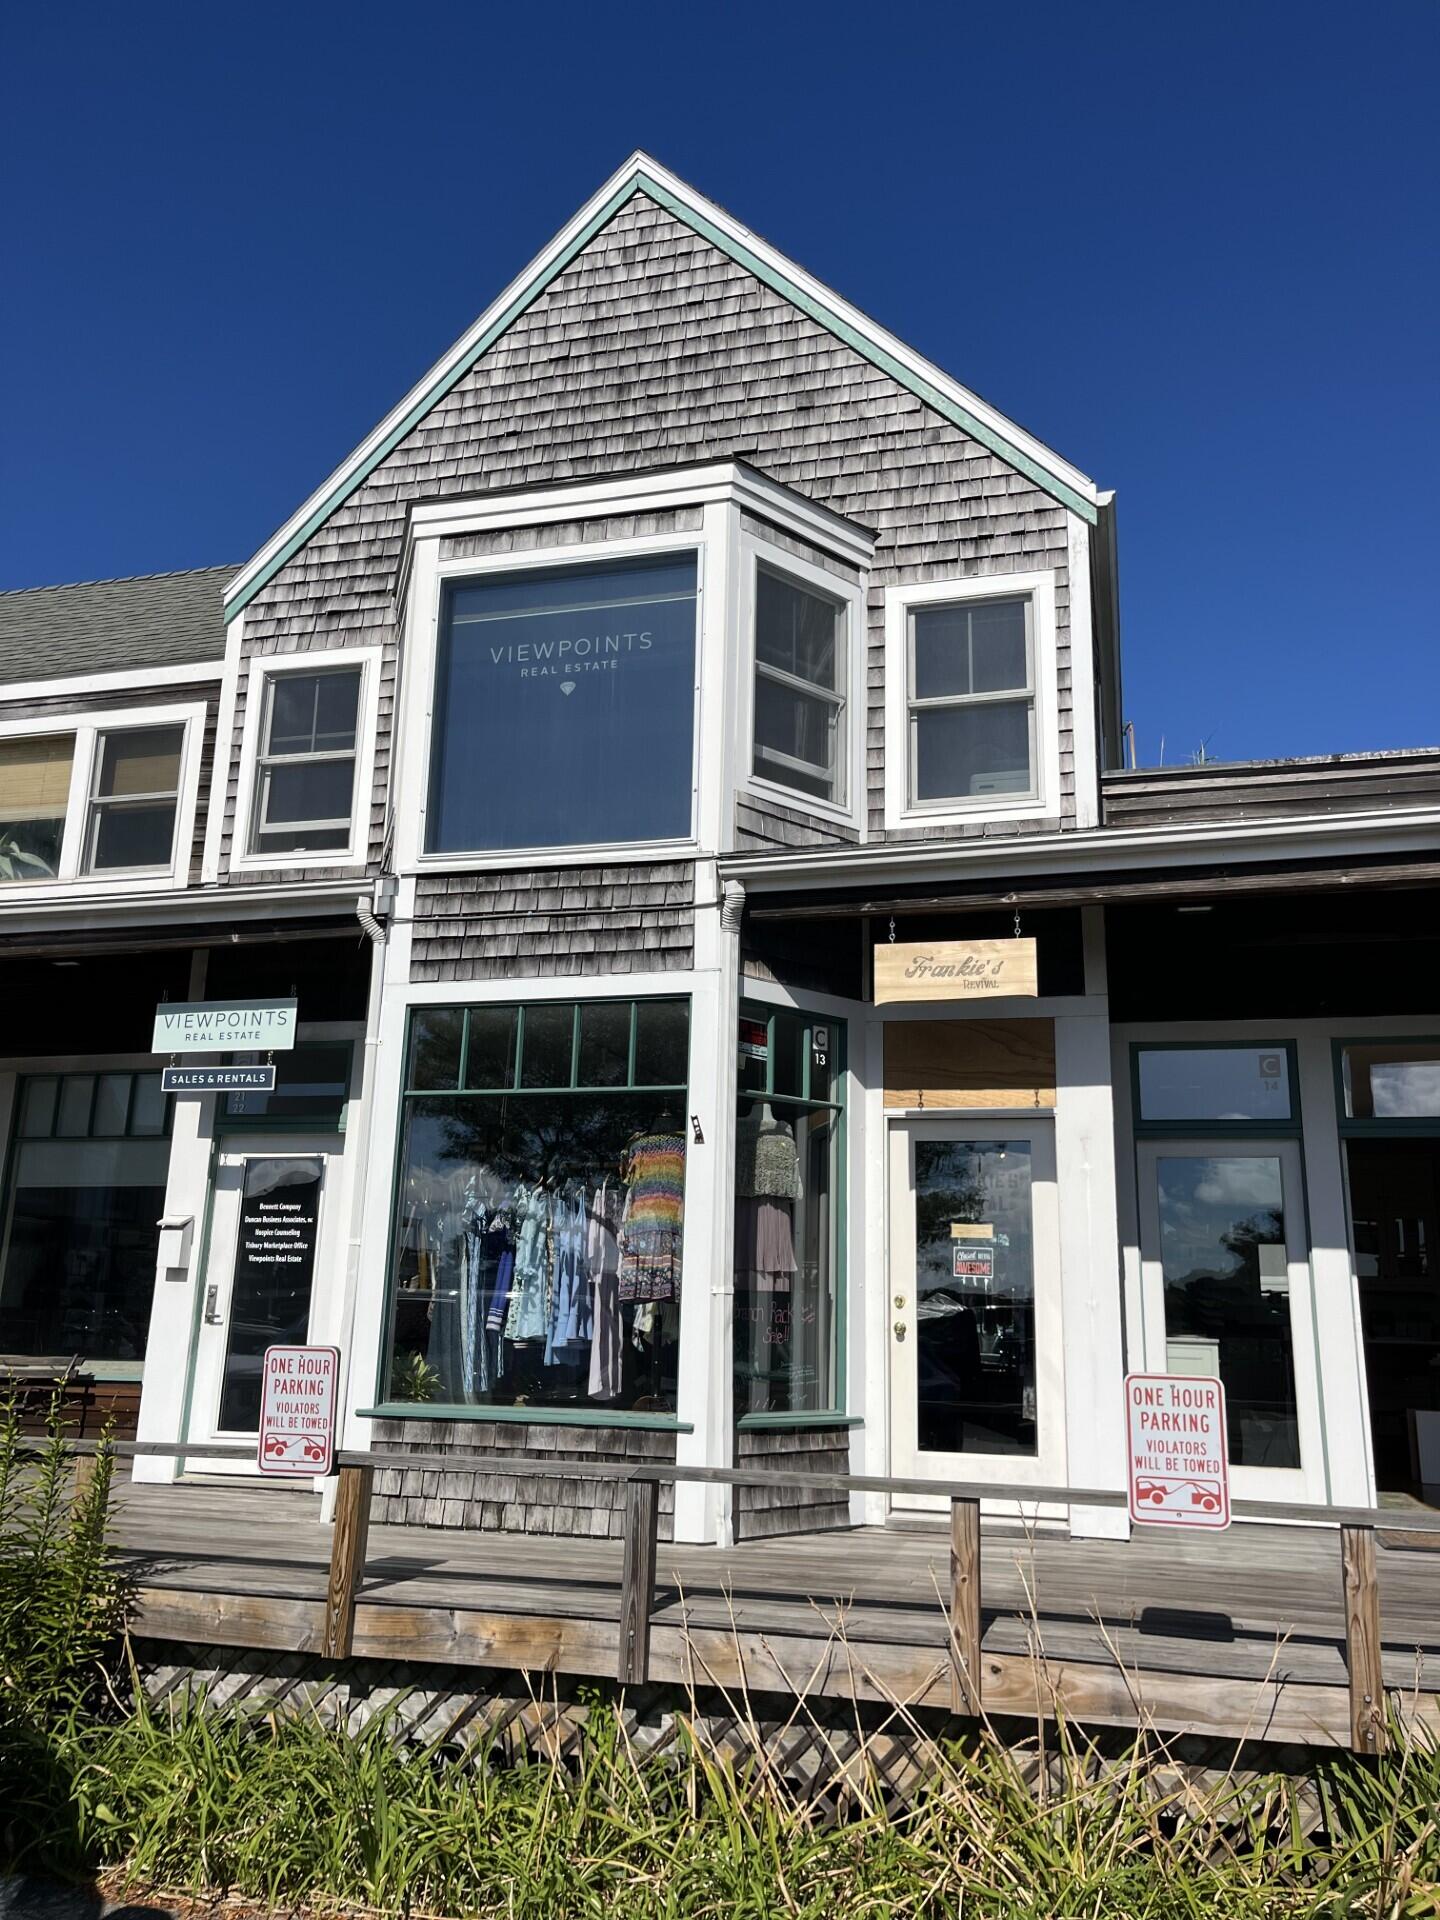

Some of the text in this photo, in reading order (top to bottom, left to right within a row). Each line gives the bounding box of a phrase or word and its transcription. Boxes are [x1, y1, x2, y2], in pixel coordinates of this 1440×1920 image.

[490, 632, 653, 664] VIEWPOINTS
[520, 659, 618, 678] REAL ESTATE
[904, 955, 1004, 978] Frankie's
[164, 1010, 288, 1029] VIEWPOINTS
[185, 1030, 261, 1041] REAL ESTATE
[815, 1030, 825, 1047] C
[815, 1053, 826, 1065] 13
[1263, 1057, 1277, 1073] C
[171, 1073, 266, 1084] SALES & RENTALS
[232, 1103, 245, 1113] 22
[259, 1202, 302, 1212] Bennett Company
[244, 1215, 262, 1223] Duncan
[262, 1215, 282, 1223] Business
[255, 1228, 301, 1237] Hospice Counseling
[245, 1241, 309, 1251] Tisbury Marketplace Office
[248, 1254, 302, 1263] Viewpoints Real Estate
[955, 1261, 992, 1275] AWESOME
[271, 1358, 331, 1375] ONE HOUR
[273, 1378, 324, 1396] PARKING
[1133, 1386, 1215, 1408] ONE HOUR
[276, 1402, 320, 1414] VIOLATORS
[266, 1416, 328, 1429] WILL BE TOWED
[1140, 1411, 1210, 1433] PARKING
[1146, 1439, 1207, 1456] VIOLATORS
[1134, 1456, 1220, 1474] WILL BE TOWED
